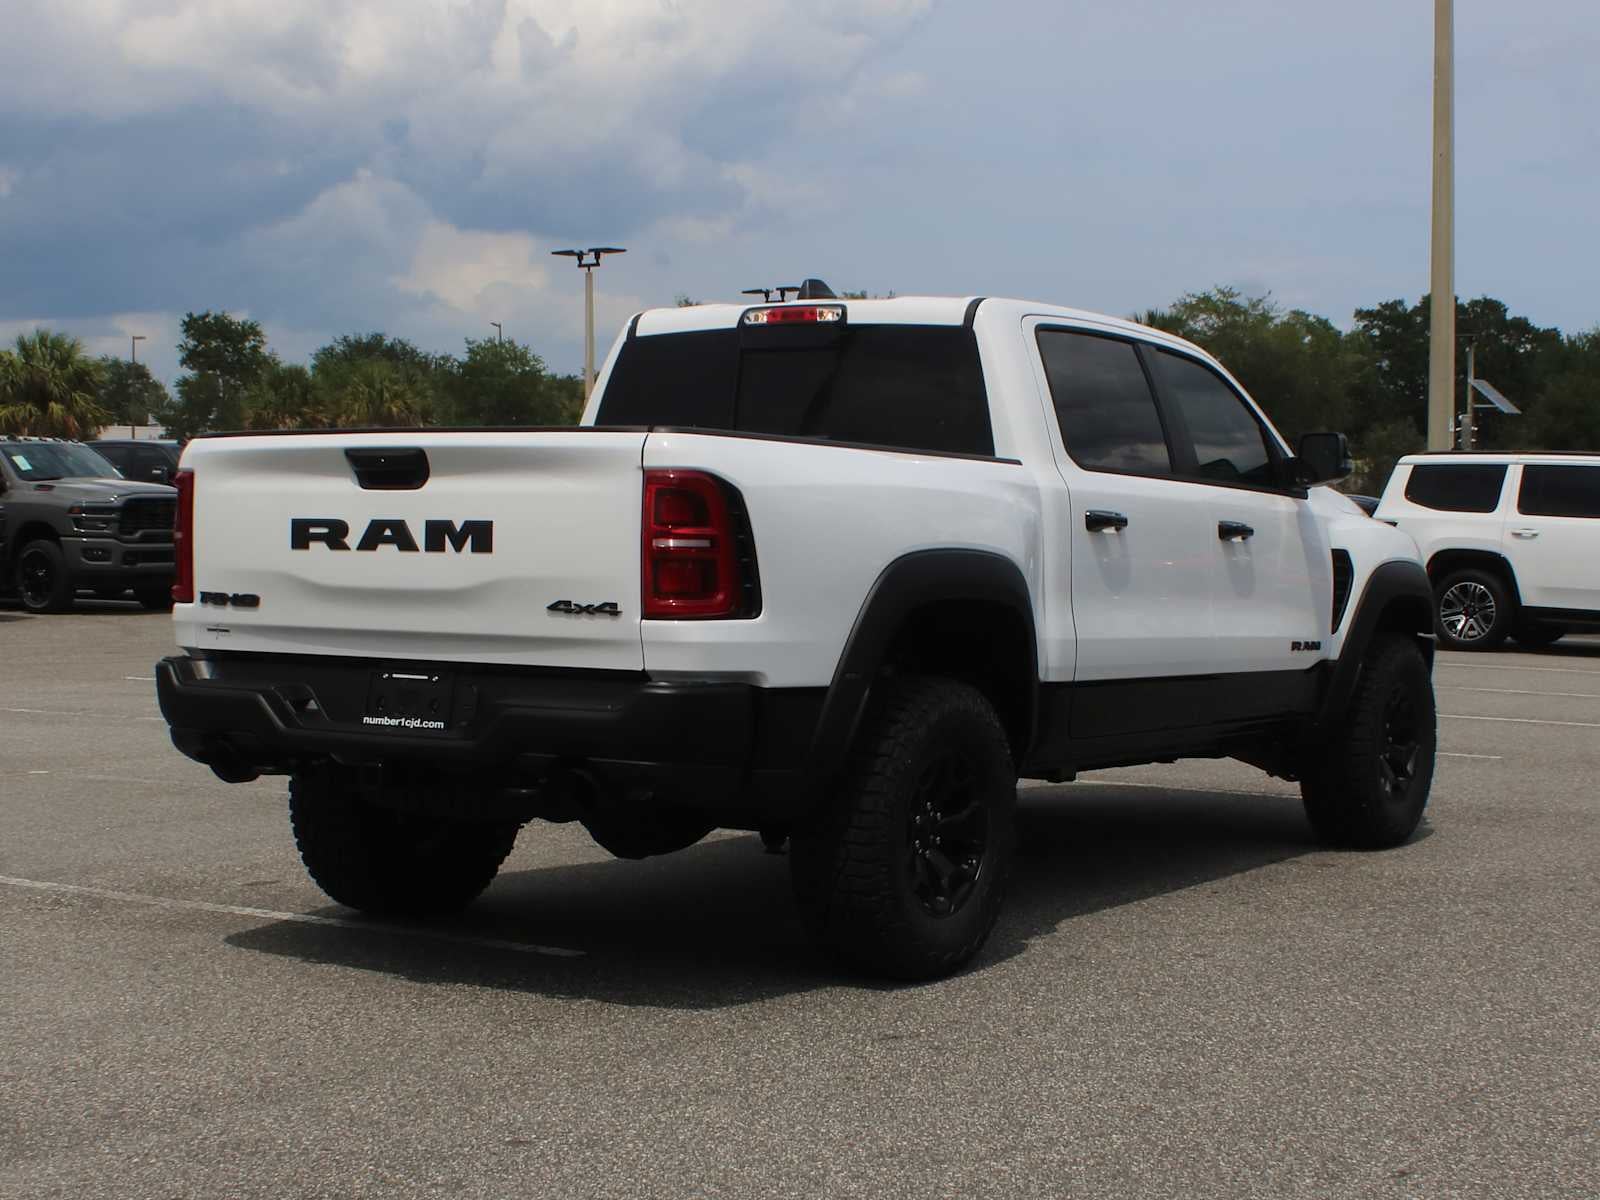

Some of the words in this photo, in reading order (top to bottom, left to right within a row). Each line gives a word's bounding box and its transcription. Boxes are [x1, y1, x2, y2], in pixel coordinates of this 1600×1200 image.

[290, 518, 493, 553] RAM
[546, 600, 622, 616] 4x4
[1291, 641, 1321, 651] RAM
[362, 716, 445, 729] number1cjd.com
